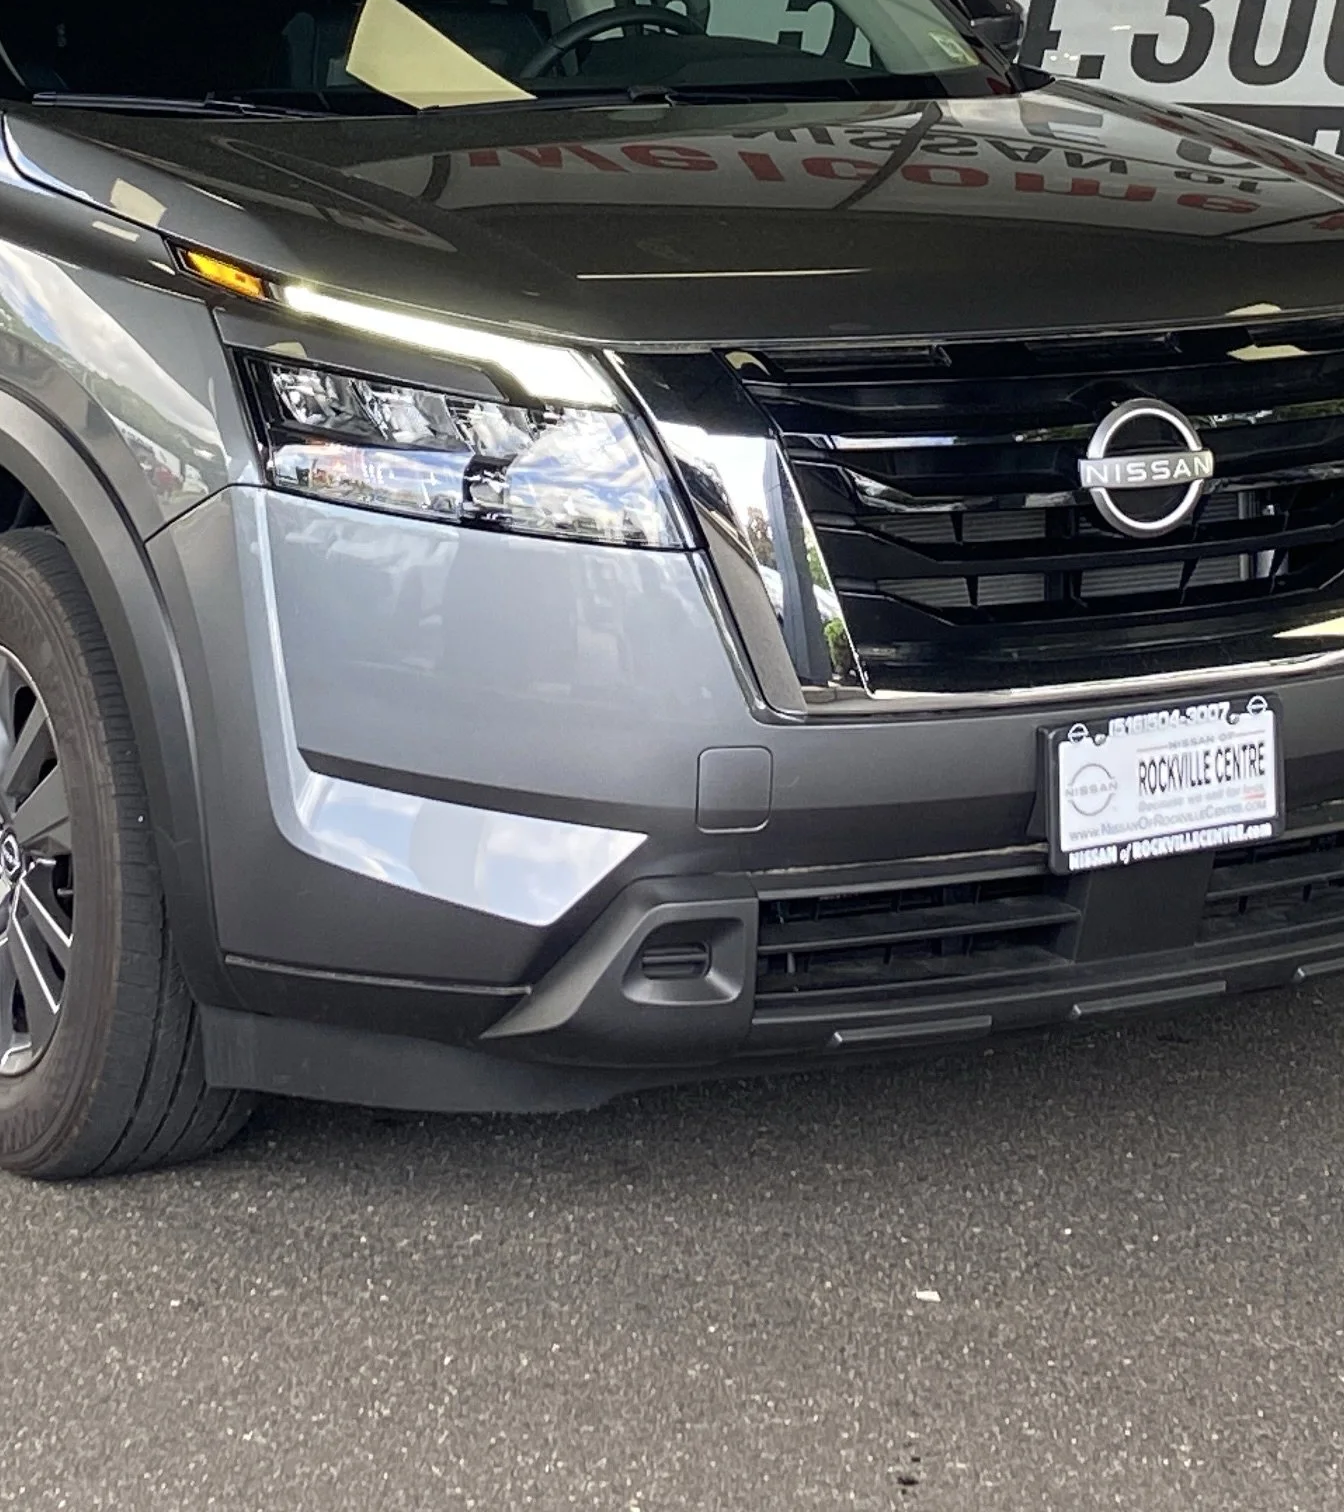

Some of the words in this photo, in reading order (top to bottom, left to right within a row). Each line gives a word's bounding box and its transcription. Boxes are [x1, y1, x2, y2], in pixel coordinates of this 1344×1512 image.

[1085, 456, 1211, 484] NISSAN
[1138, 752, 1210, 795] ROCKVILLE
[1215, 742, 1266, 784] CENTRE
[1065, 781, 1118, 797] NISSAN
[1069, 845, 1117, 871] NISSAN
[1120, 843, 1131, 865] of
